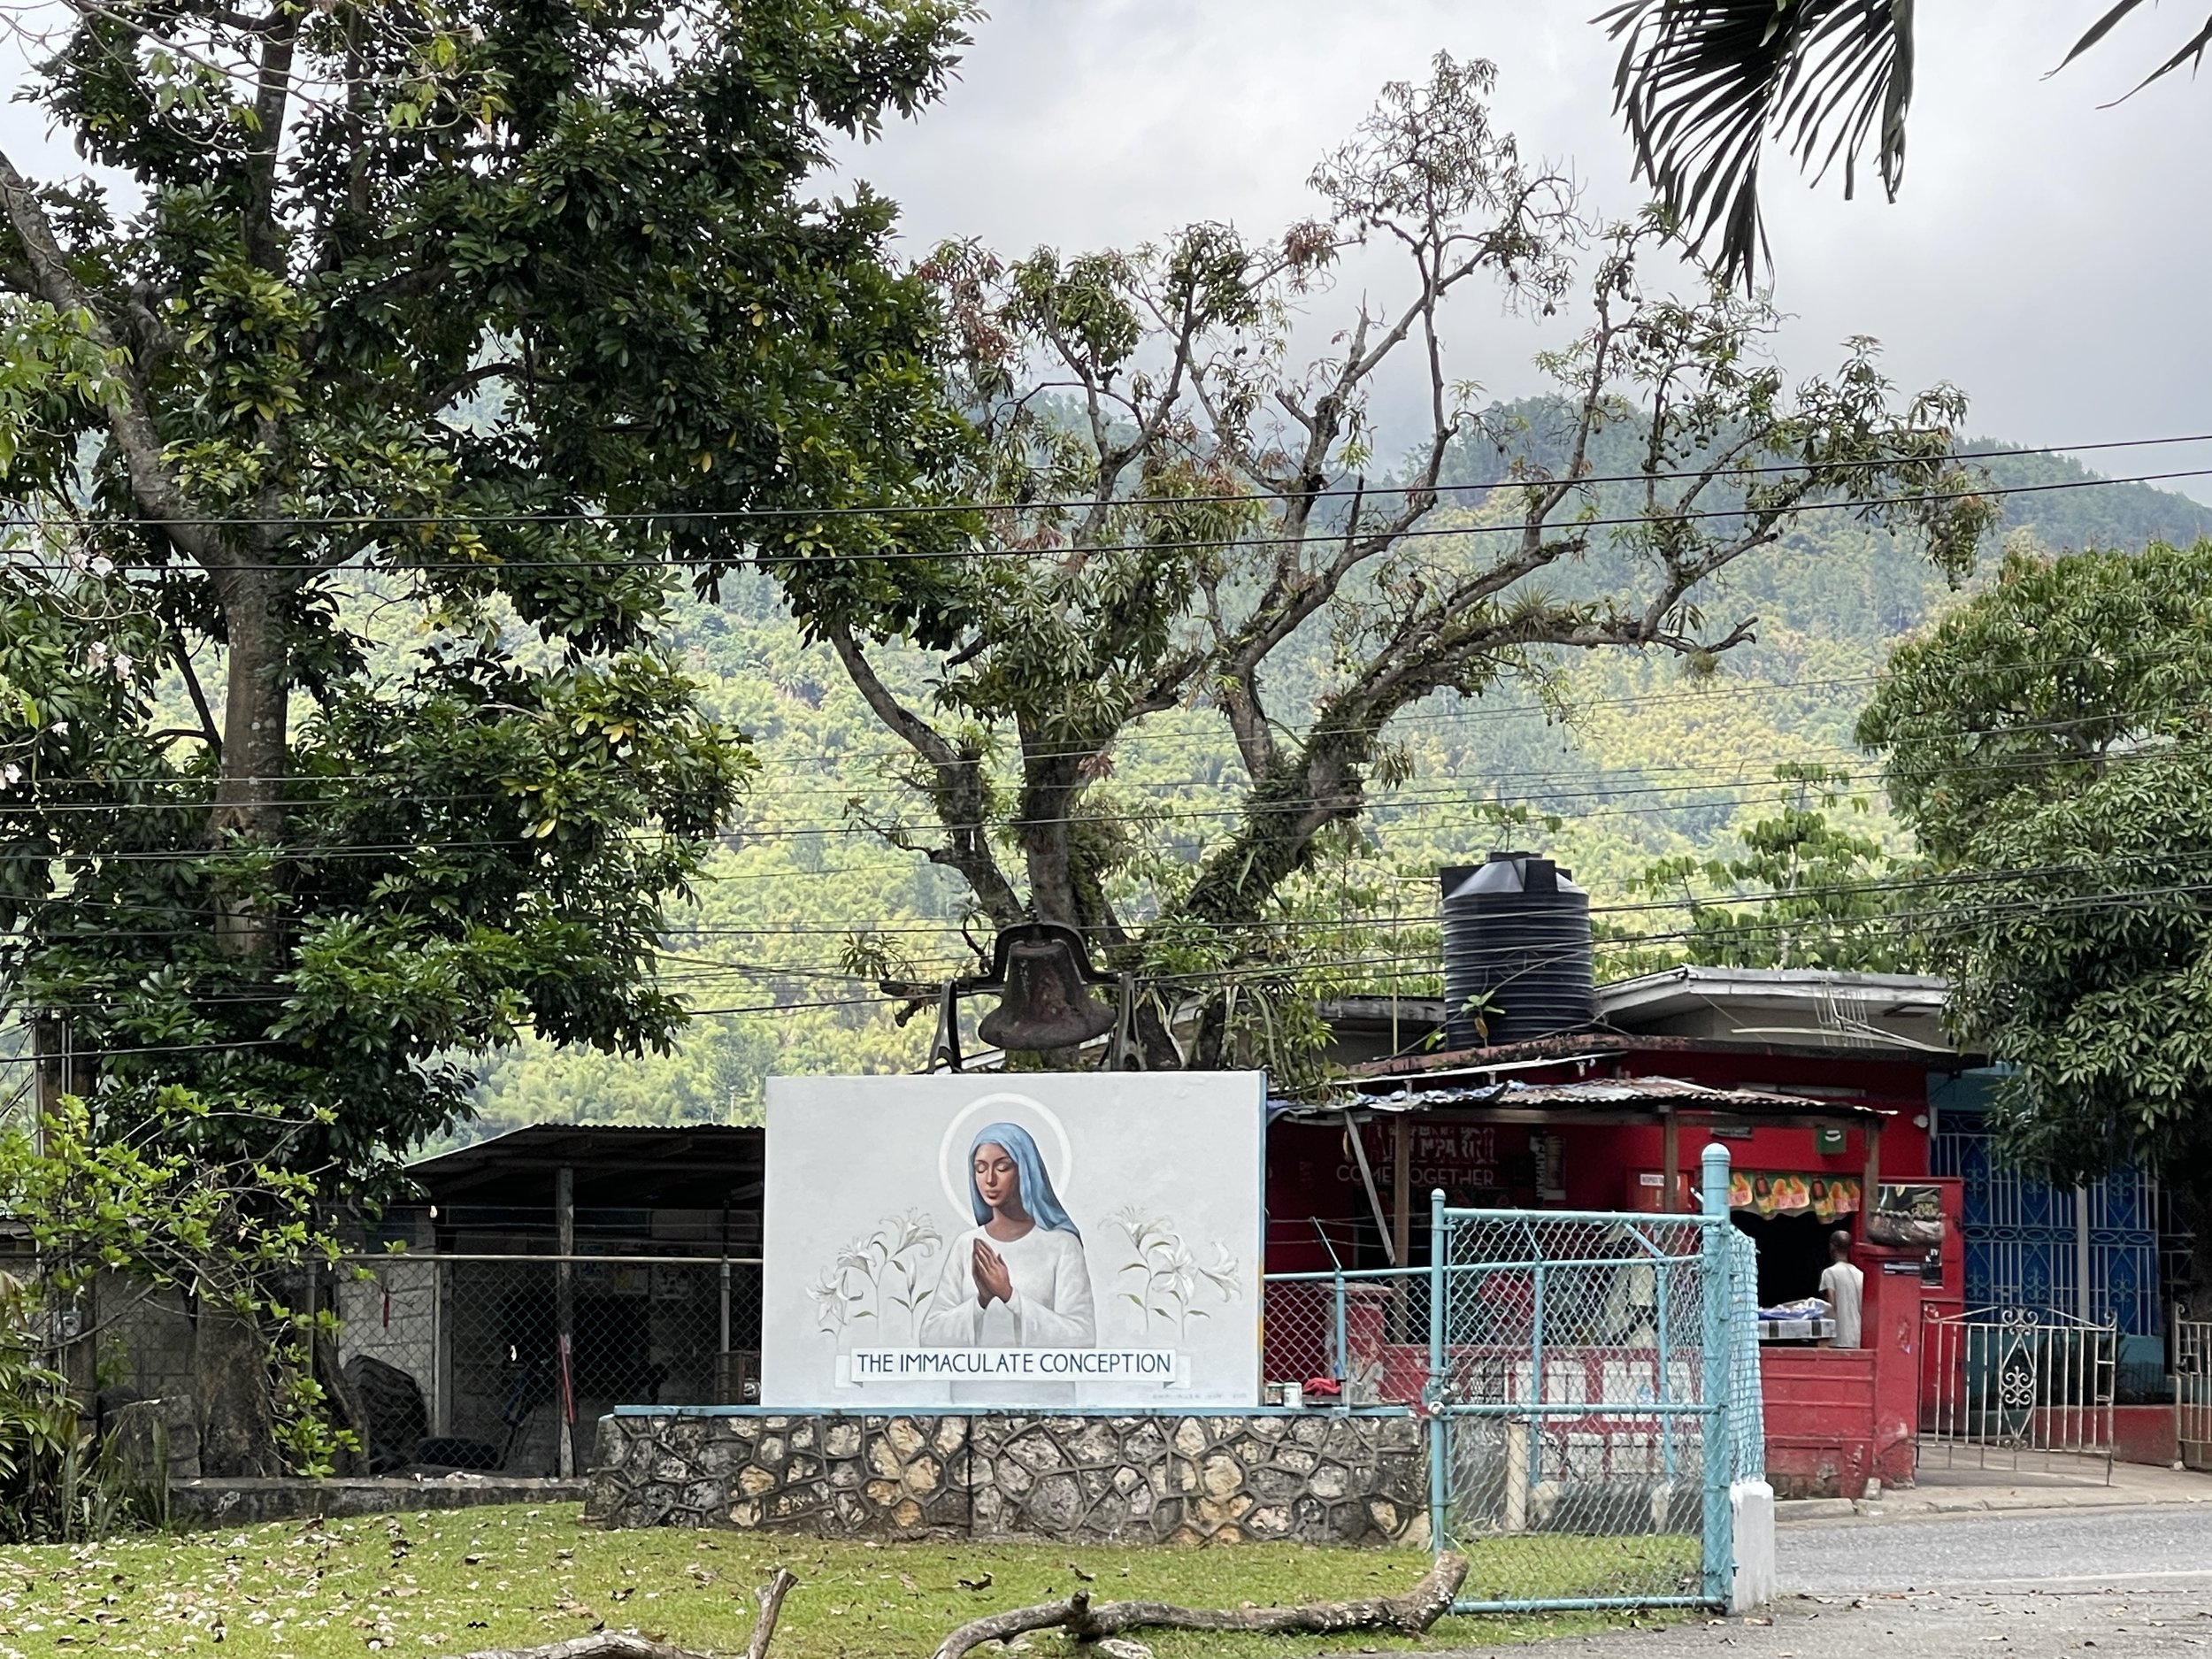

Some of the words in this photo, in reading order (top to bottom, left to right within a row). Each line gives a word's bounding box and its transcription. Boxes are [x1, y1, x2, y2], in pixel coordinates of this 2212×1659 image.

[1409, 1168, 1494, 1187] OGETHER
[856, 1354, 894, 1372] THE
[900, 1353, 1033, 1372] IMMACULATE
[1040, 1353, 1171, 1372] CONCEPTION
